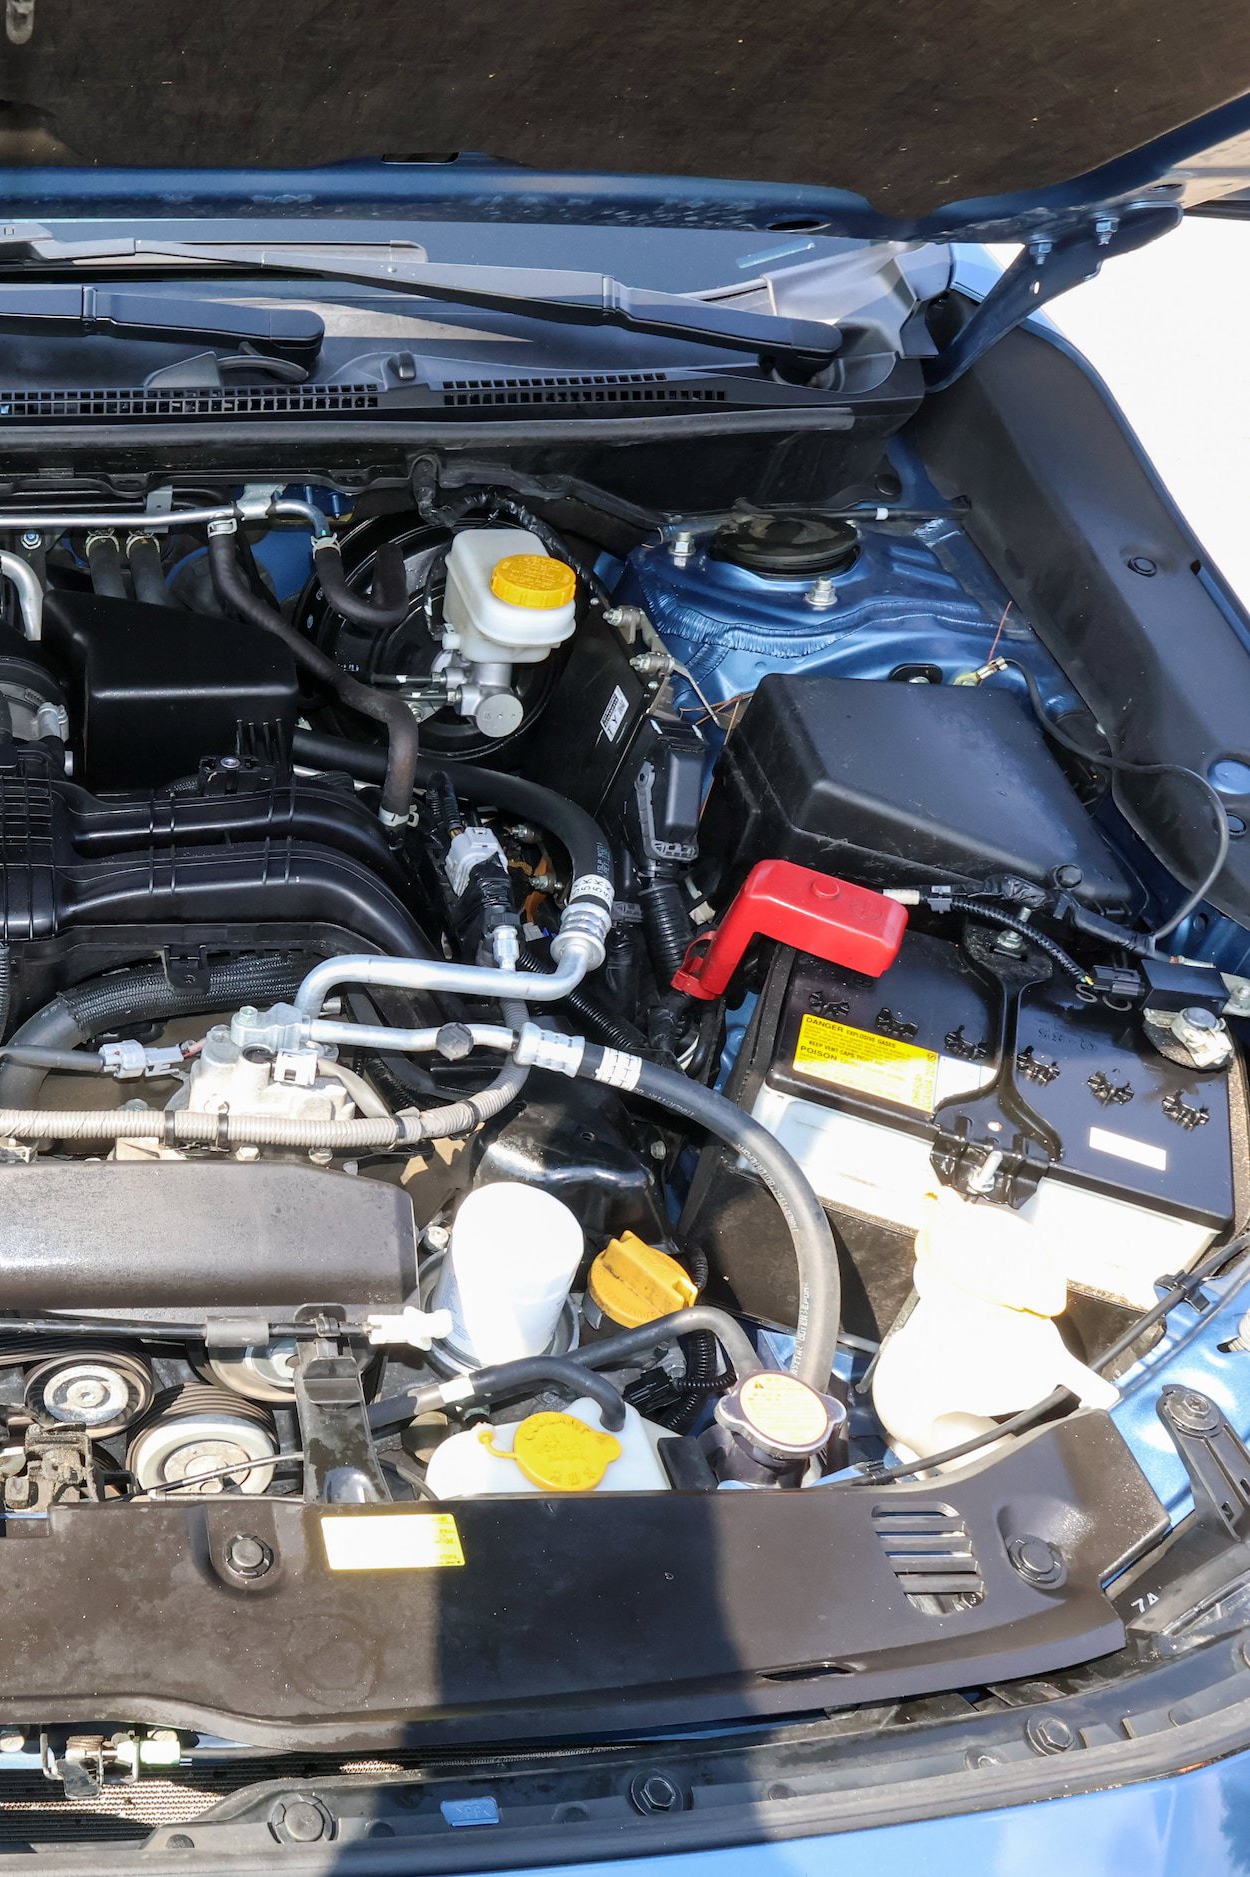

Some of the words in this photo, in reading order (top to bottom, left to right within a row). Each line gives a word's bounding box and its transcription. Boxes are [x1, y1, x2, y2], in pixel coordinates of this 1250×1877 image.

[805, 1016, 844, 1034] DANGER
[846, 1030, 876, 1043] EXPLOSIVE
[877, 1036, 896, 1049] GASES
[800, 1045, 838, 1061] POISON
